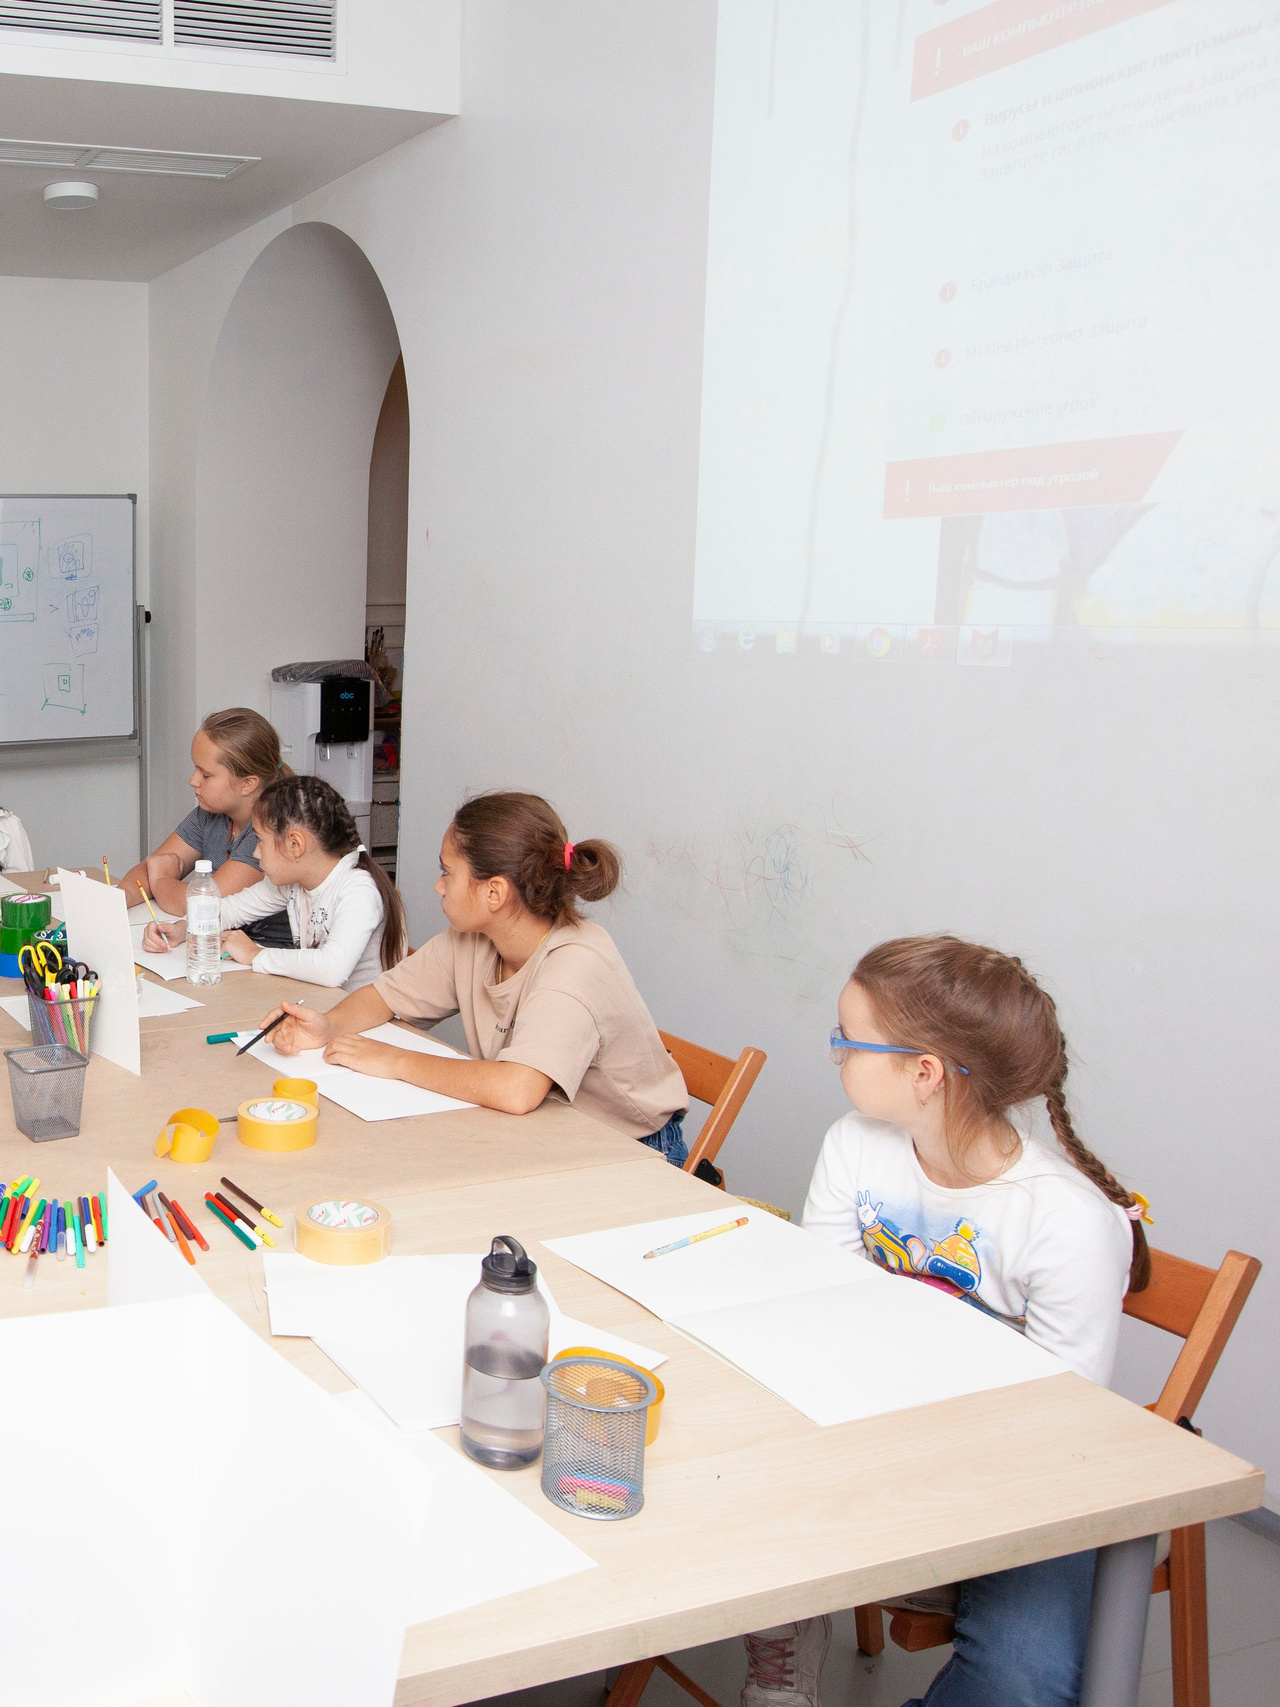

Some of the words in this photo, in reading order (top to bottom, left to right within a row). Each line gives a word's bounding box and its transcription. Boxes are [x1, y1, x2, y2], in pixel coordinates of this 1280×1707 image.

[962, 37, 991, 58] ВАШ
[993, 3, 1077, 45] КОМПЬЮТЕР
[984, 99, 1038, 127] Вирусы
[1041, 93, 1052, 107] и
[1054, 60, 1149, 102] шпионские
[1151, 21, 1262, 69] программы
[979, 151, 1048, 182] Защитите
[1051, 135, 1087, 160] свой
[1091, 127, 1111, 146] ПК
[1116, 123, 1135, 138] от
[1138, 94, 1229, 130] новейших
[1234, 78, 1280, 109] угро
[981, 145, 1000, 160] На
[1003, 112, 1094, 153] компьютере
[1097, 104, 1117, 122] не
[1121, 80, 1195, 114] найдена
[970, 263, 1052, 293] Брандмауэр
[1056, 250, 1114, 273] Защита
[965, 341, 1012, 360] McAfee
[1015, 327, 1084, 351] Интернет
[1088, 316, 1148, 338] Защита
[960, 402, 1054, 426] Обнаружение
[1055, 398, 1097, 418] угроз
[928, 482, 951, 494] Ваш
[954, 477, 1019, 491] компьютер
[1021, 474, 1045, 487] под
[1047, 467, 1099, 487] угрозой
[340, 691, 354, 699] abc
